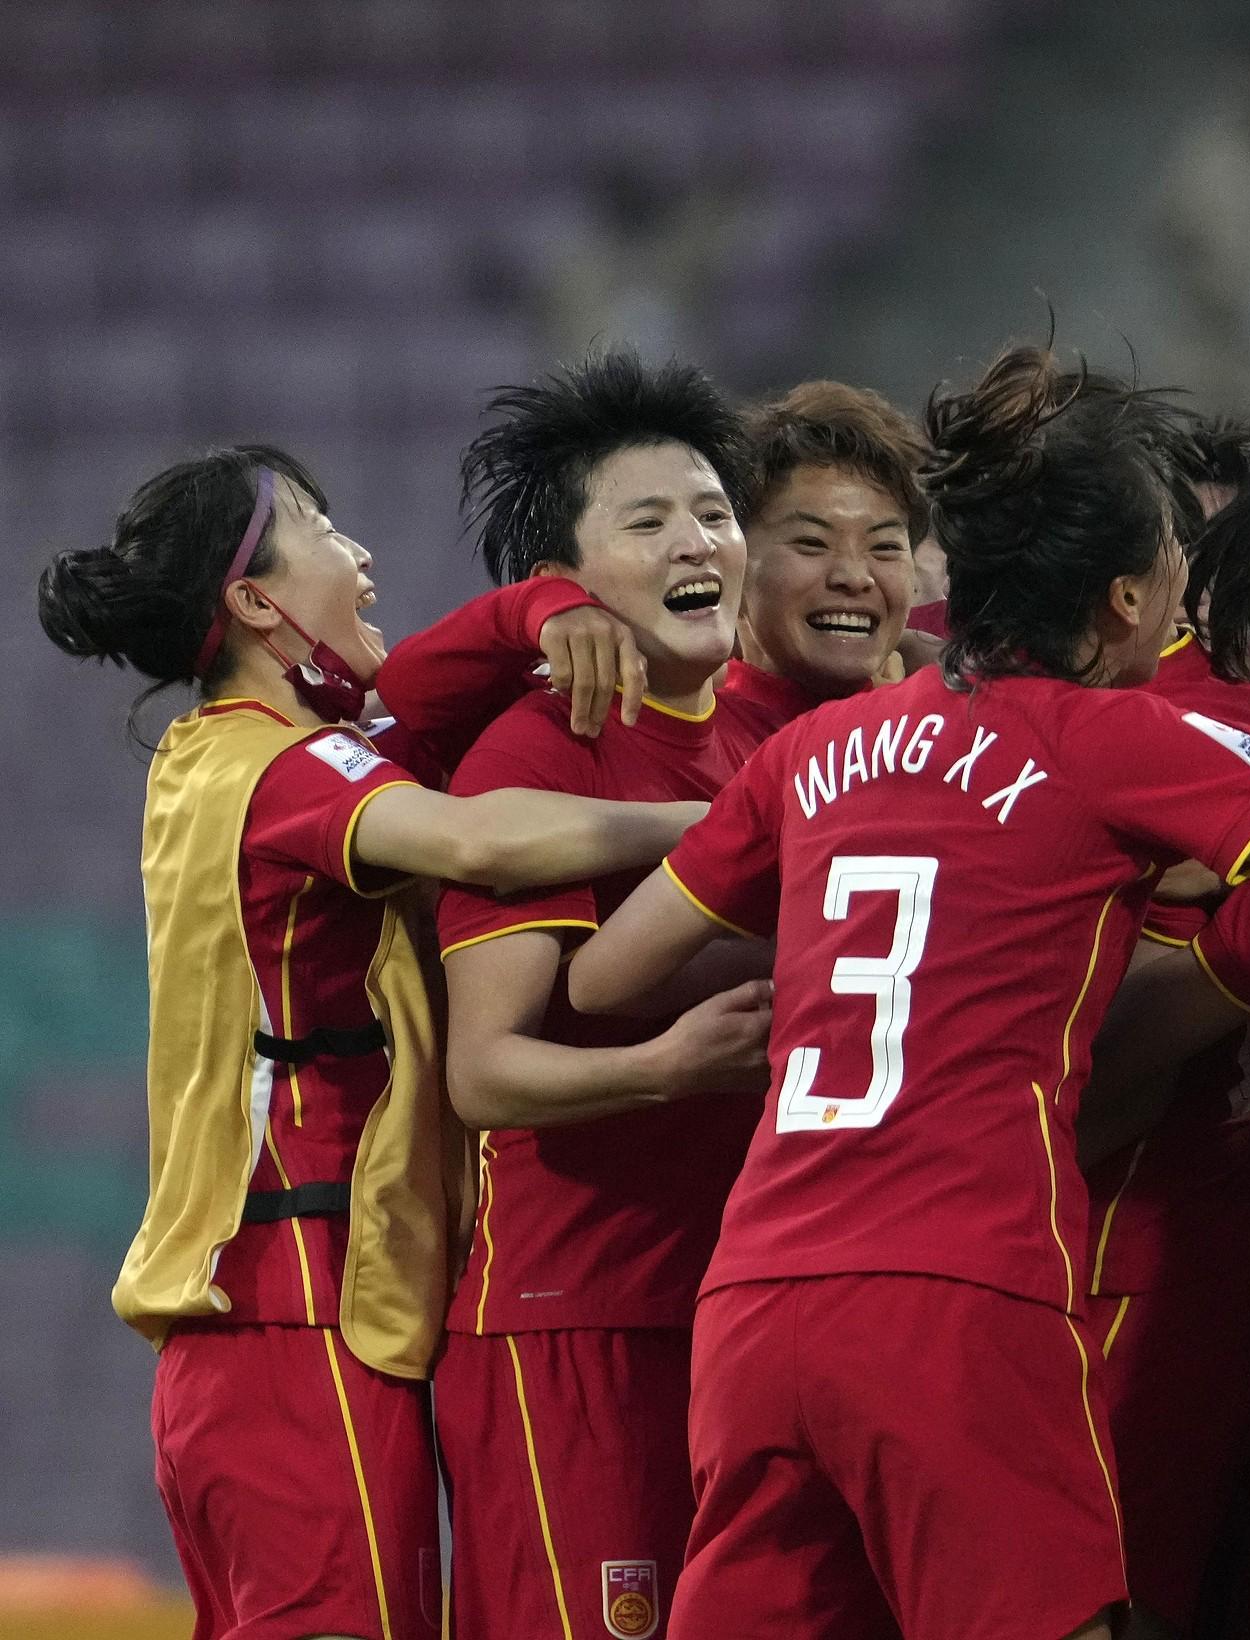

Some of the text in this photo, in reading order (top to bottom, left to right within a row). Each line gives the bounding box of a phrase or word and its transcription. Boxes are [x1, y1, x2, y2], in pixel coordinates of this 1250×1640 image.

[793, 714, 1048, 825] WANG X X
[776, 856, 939, 1135] 3
[609, 1568, 651, 1581] CFA
